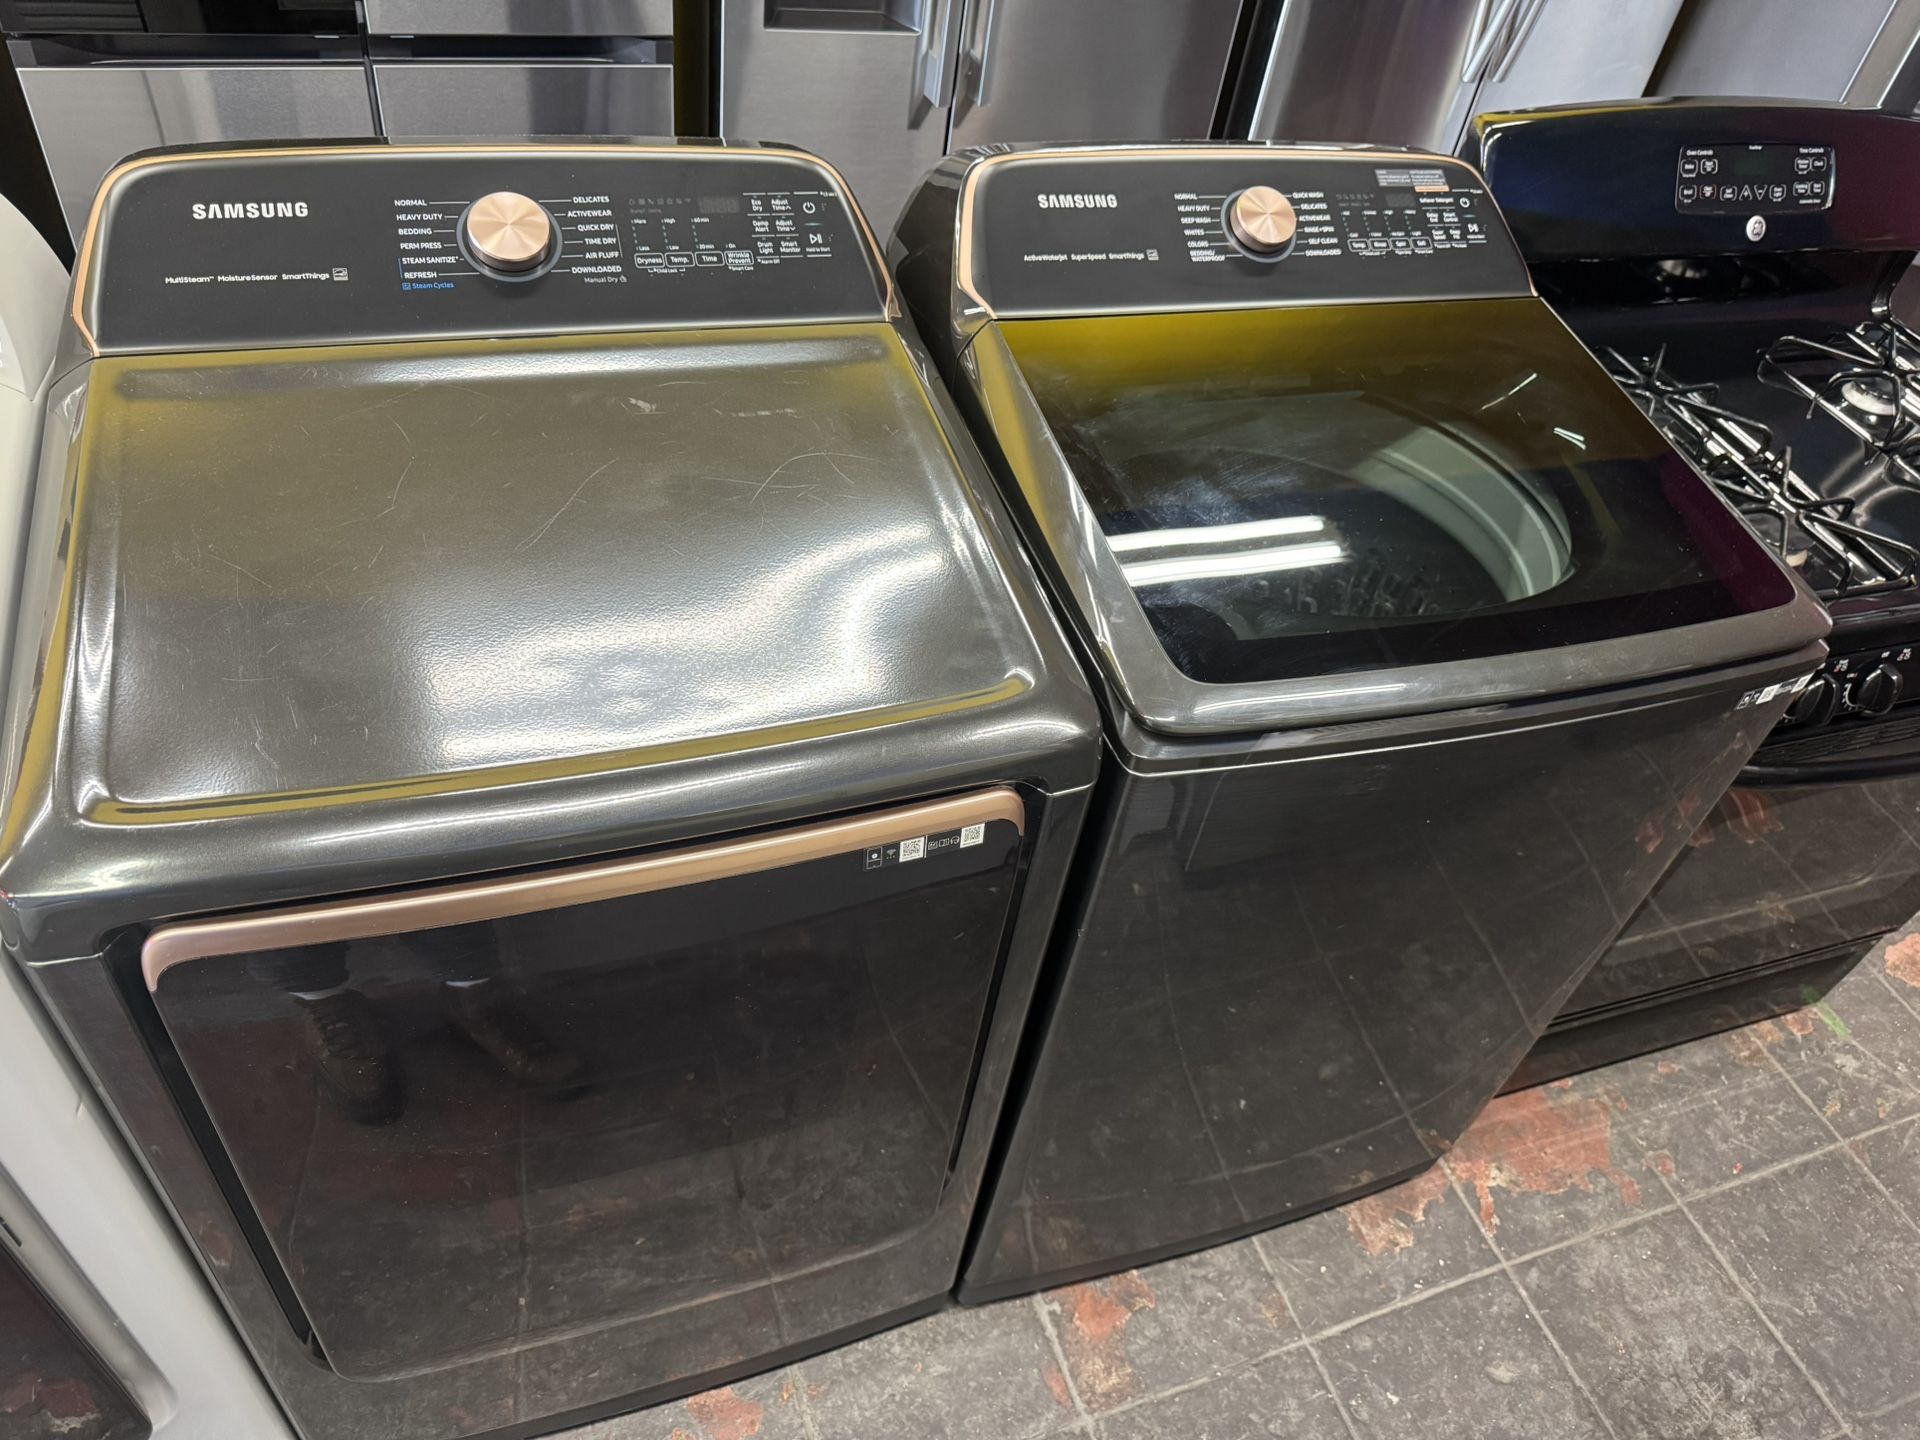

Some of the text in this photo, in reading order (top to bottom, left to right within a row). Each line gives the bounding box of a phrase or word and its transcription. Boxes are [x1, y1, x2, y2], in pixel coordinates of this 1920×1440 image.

[1037, 194, 1118, 208] SAMSUNG
[192, 202, 308, 219] SAMSUNG
[598, 251, 619, 259] FLUFF
[1305, 248, 1342, 256] DOWNLOADED
[1071, 253, 1106, 262] SuperSpeed
[1108, 252, 1145, 260] SmartThings
[217, 273, 278, 282] MoistureSensor
[281, 272, 330, 281] SmartThings
[607, 276, 618, 284] Dry
[433, 282, 454, 290] Cycles
